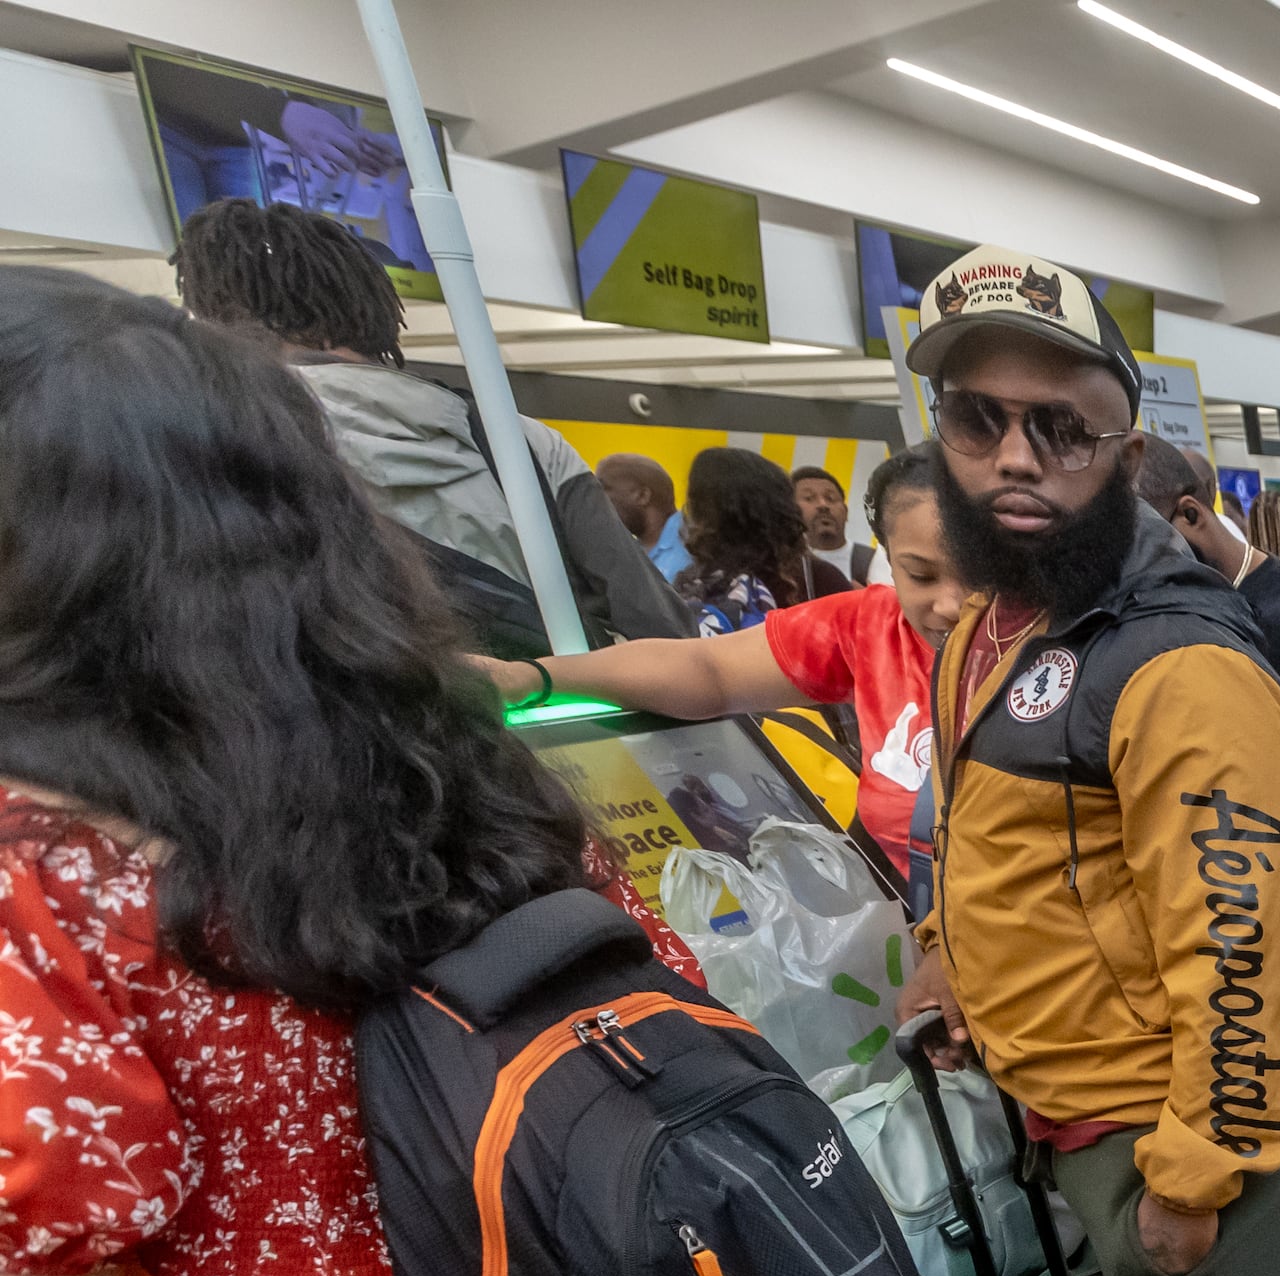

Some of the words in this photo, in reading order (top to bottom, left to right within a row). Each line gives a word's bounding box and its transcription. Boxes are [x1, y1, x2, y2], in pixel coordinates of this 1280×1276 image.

[643, 261, 678, 286] Self
[682, 268, 715, 298] Bag
[718, 273, 757, 303] Drop
[960, 264, 1022, 286] WARNING
[968, 281, 1015, 297] BEWARE
[970, 294, 983, 307] OF
[987, 293, 1013, 303] DOG
[706, 306, 758, 327] spirit
[1142, 374, 1160, 396] tep
[1160, 376, 1168, 394] 2
[1028, 652, 1072, 689] ROPOSTALE
[1013, 686, 1027, 710] NEW
[1026, 699, 1051, 715] YORK
[600, 799, 658, 822] More
[606, 825, 682, 865] pace
